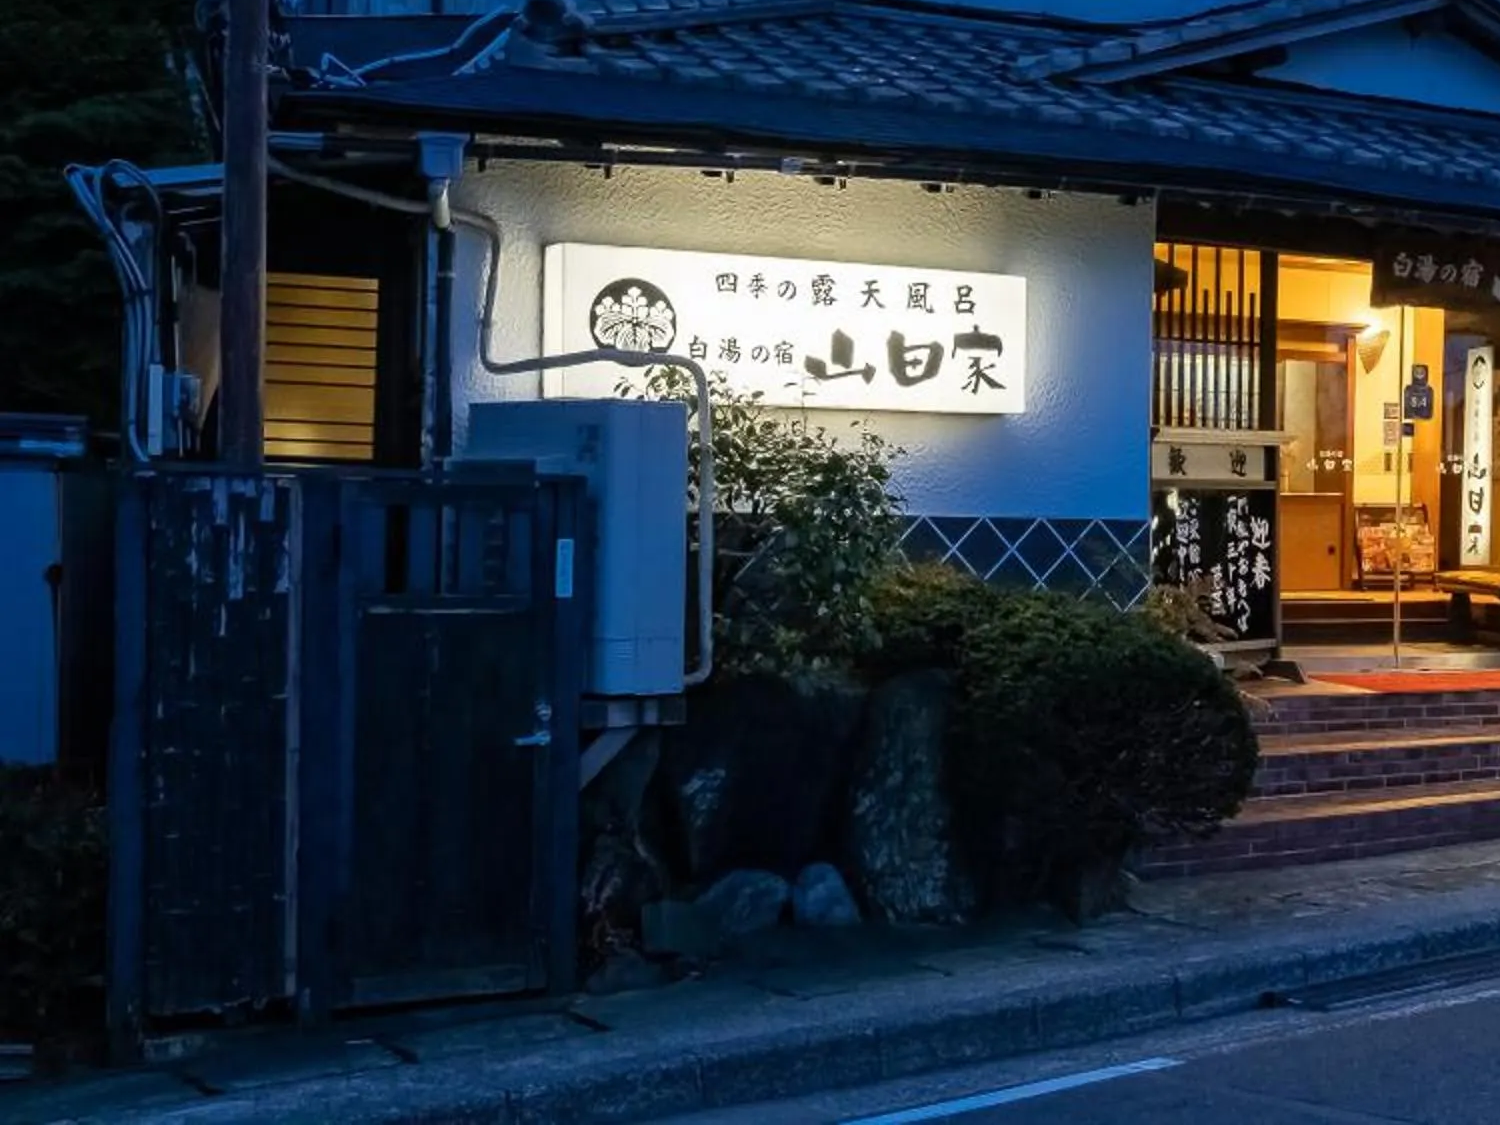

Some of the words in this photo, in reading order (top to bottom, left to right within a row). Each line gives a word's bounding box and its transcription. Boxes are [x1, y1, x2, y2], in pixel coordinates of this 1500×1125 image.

[1392, 252, 1484, 289] 白湯の宿
[715, 272, 976, 315] 四季の露天風呂
[688, 334, 795, 365] 白湯の宿
[804, 324, 1007, 395] 山田家
